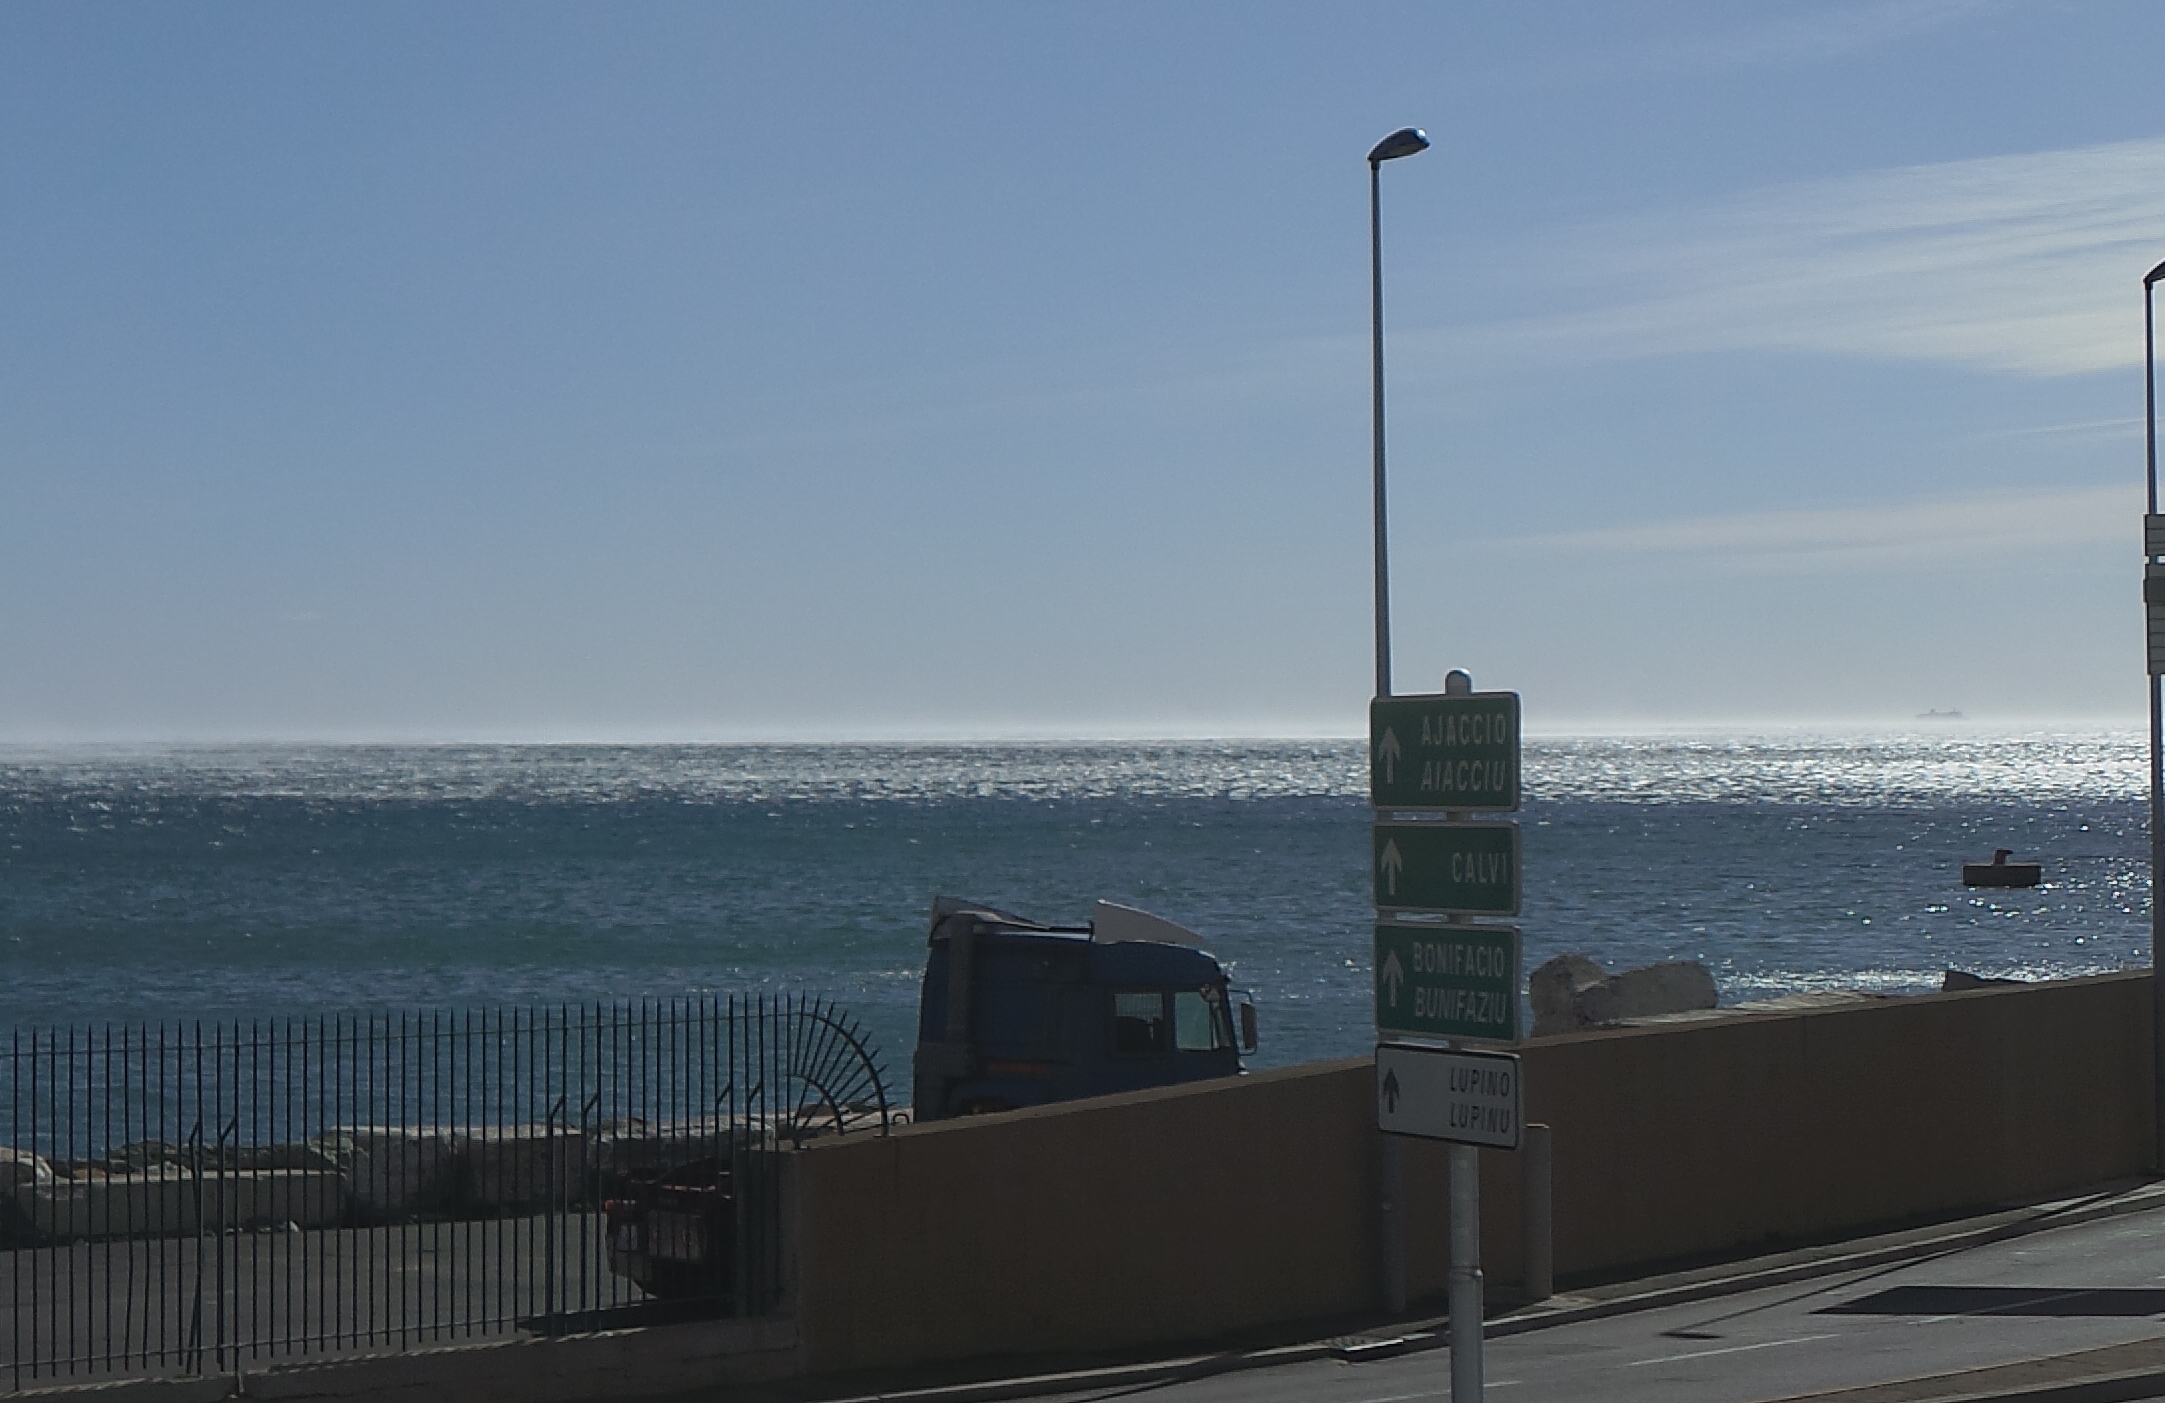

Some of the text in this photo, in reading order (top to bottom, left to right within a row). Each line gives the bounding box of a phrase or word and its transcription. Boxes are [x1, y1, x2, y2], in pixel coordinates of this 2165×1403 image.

[1421, 714, 1506, 746] AJACCIO
[1420, 760, 1506, 791] AIACCIU
[1452, 852, 1506, 884] CALVI
[1413, 941, 1504, 977] BONIFACIO
[1415, 986, 1507, 1024] BUNIFAZIU
[1450, 1067, 1510, 1097] LUPINO
[1450, 1101, 1510, 1133] LUPINU
